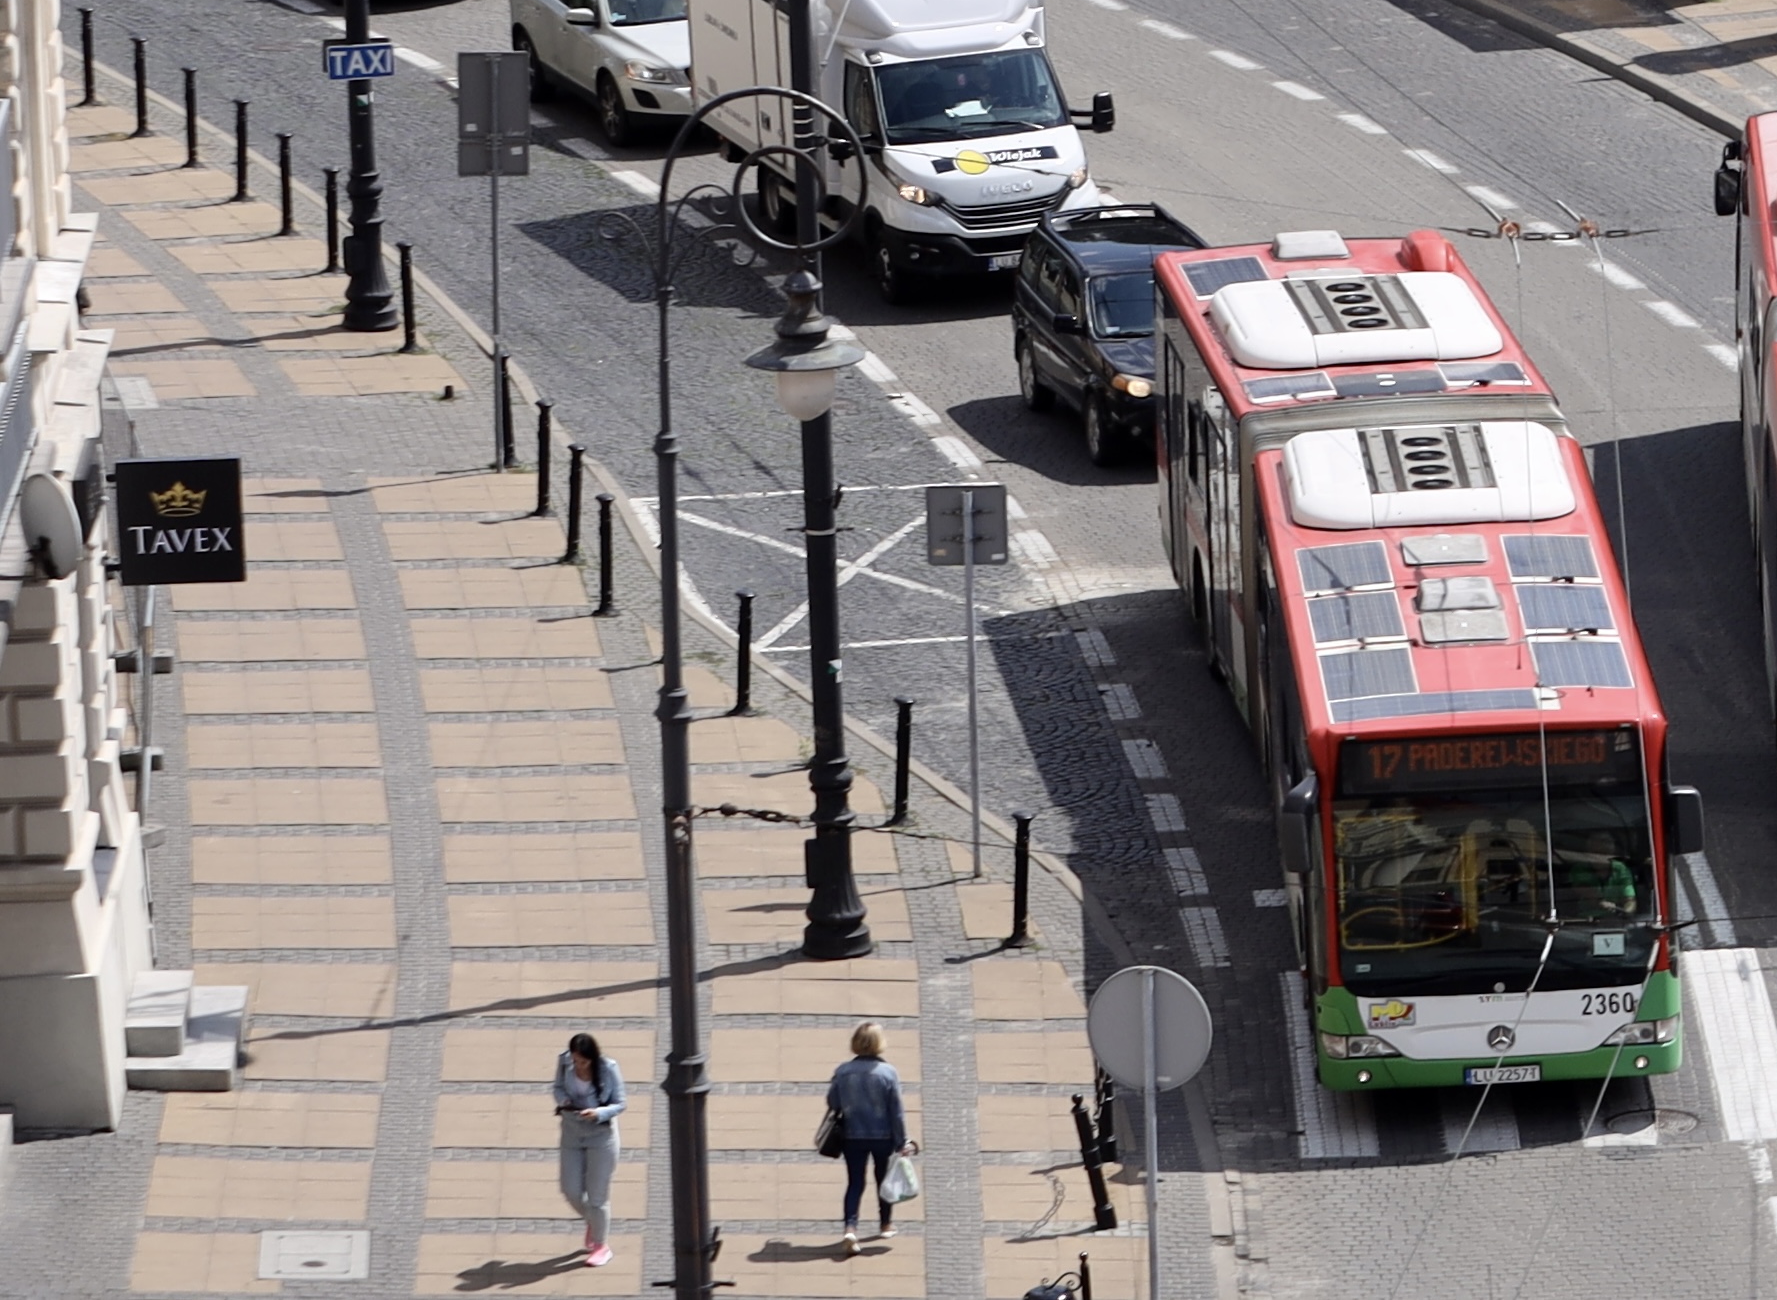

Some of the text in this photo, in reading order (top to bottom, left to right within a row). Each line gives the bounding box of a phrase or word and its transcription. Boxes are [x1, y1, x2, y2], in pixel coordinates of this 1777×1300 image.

[329, 48, 392, 77] TAXI
[989, 147, 1042, 164] Wiejak
[980, 179, 1034, 198] IVECO
[127, 525, 233, 556] TAVEX
[1367, 736, 1607, 780] 17 PADEREWSKIEGO
[1603, 937, 1614, 949] V
[1580, 992, 1635, 1016] 2360
